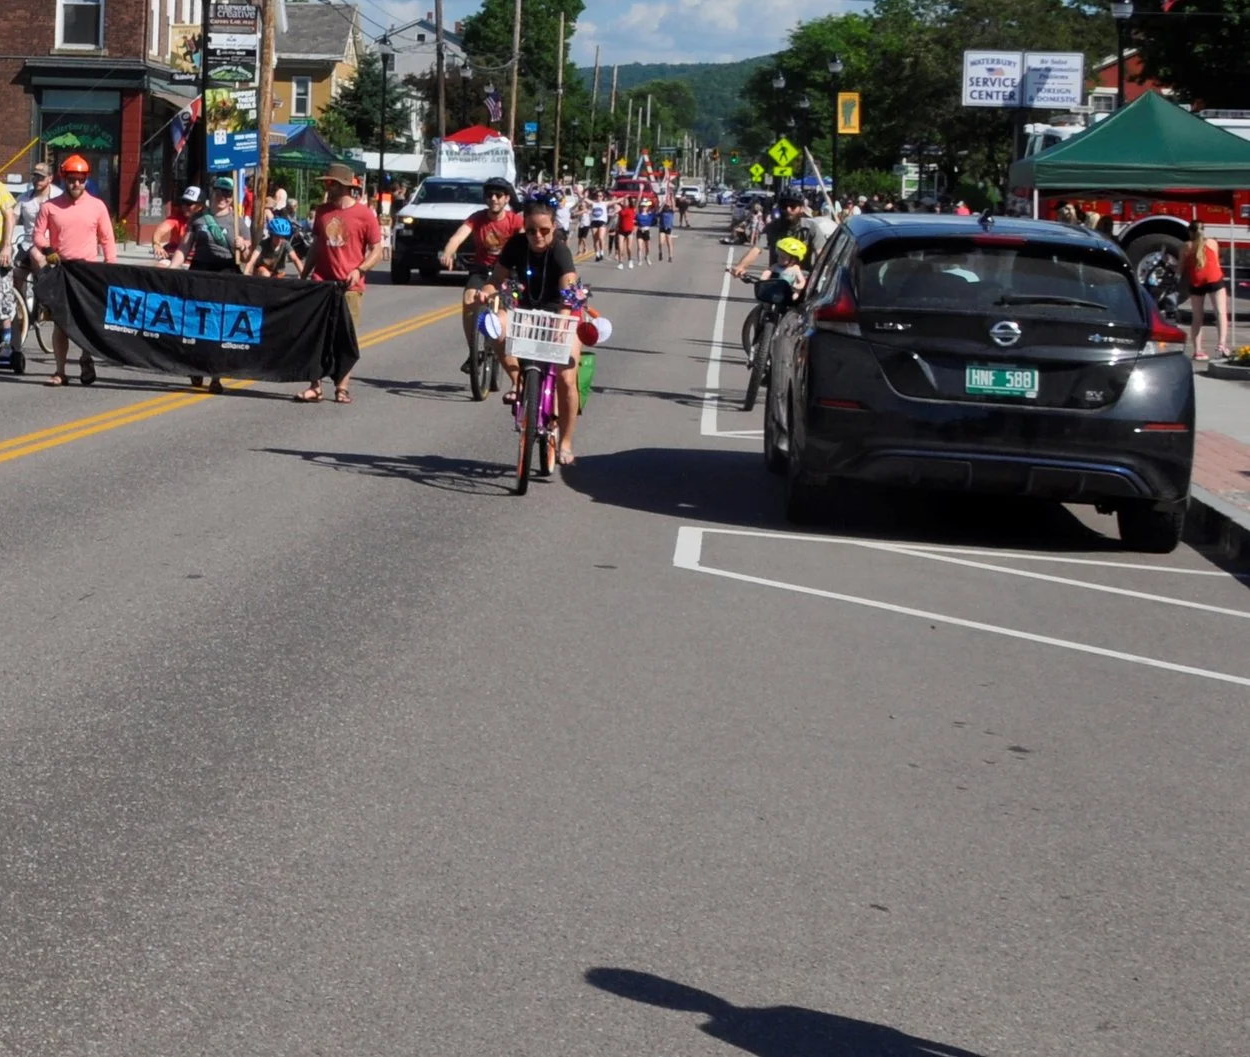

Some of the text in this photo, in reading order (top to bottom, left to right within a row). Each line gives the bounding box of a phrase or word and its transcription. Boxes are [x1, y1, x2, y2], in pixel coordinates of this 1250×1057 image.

[969, 57, 1017, 68] WATERBURY
[968, 76, 1018, 88] SERVICE
[969, 89, 1016, 101] CENTER
[1036, 87, 1071, 95] FOREIGN
[1036, 95, 1078, 103] DOMESTIC
[109, 291, 254, 339] WATA
[221, 342, 250, 350] alliance
[971, 369, 1032, 388] HNF 588
